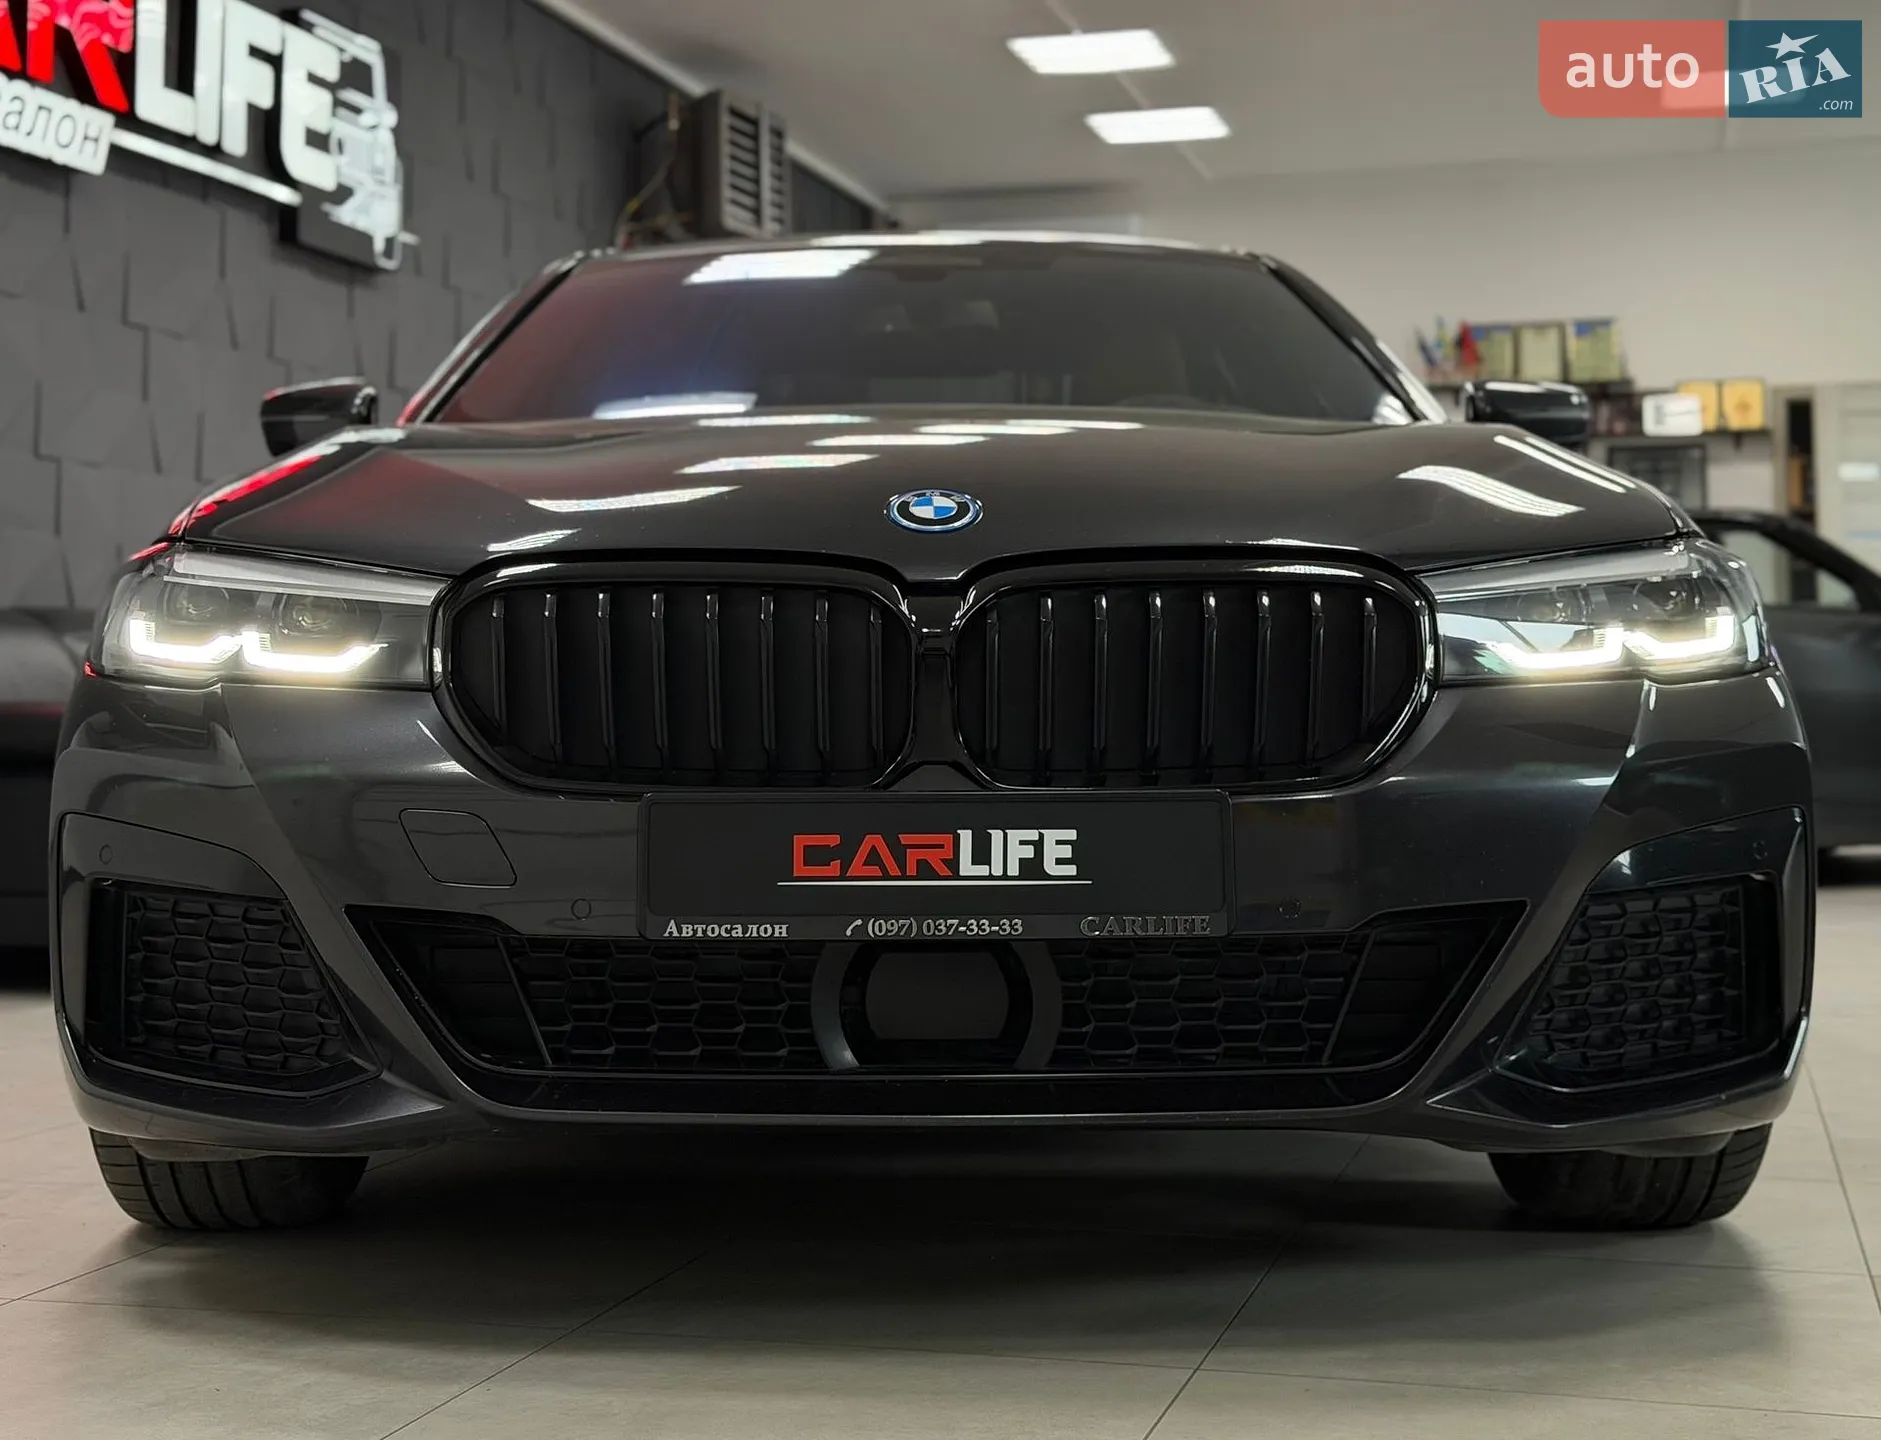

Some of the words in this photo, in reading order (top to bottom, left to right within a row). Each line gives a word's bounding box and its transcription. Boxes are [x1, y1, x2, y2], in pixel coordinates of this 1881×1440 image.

[0, 94, 103, 159] алон
[792, 828, 1078, 877] CARLIFE
[663, 918, 790, 938] Автосалон
[867, 917, 917, 938] (097)
[922, 918, 1023, 937] 037-33-33
[1080, 915, 1212, 937] CARLIFE
